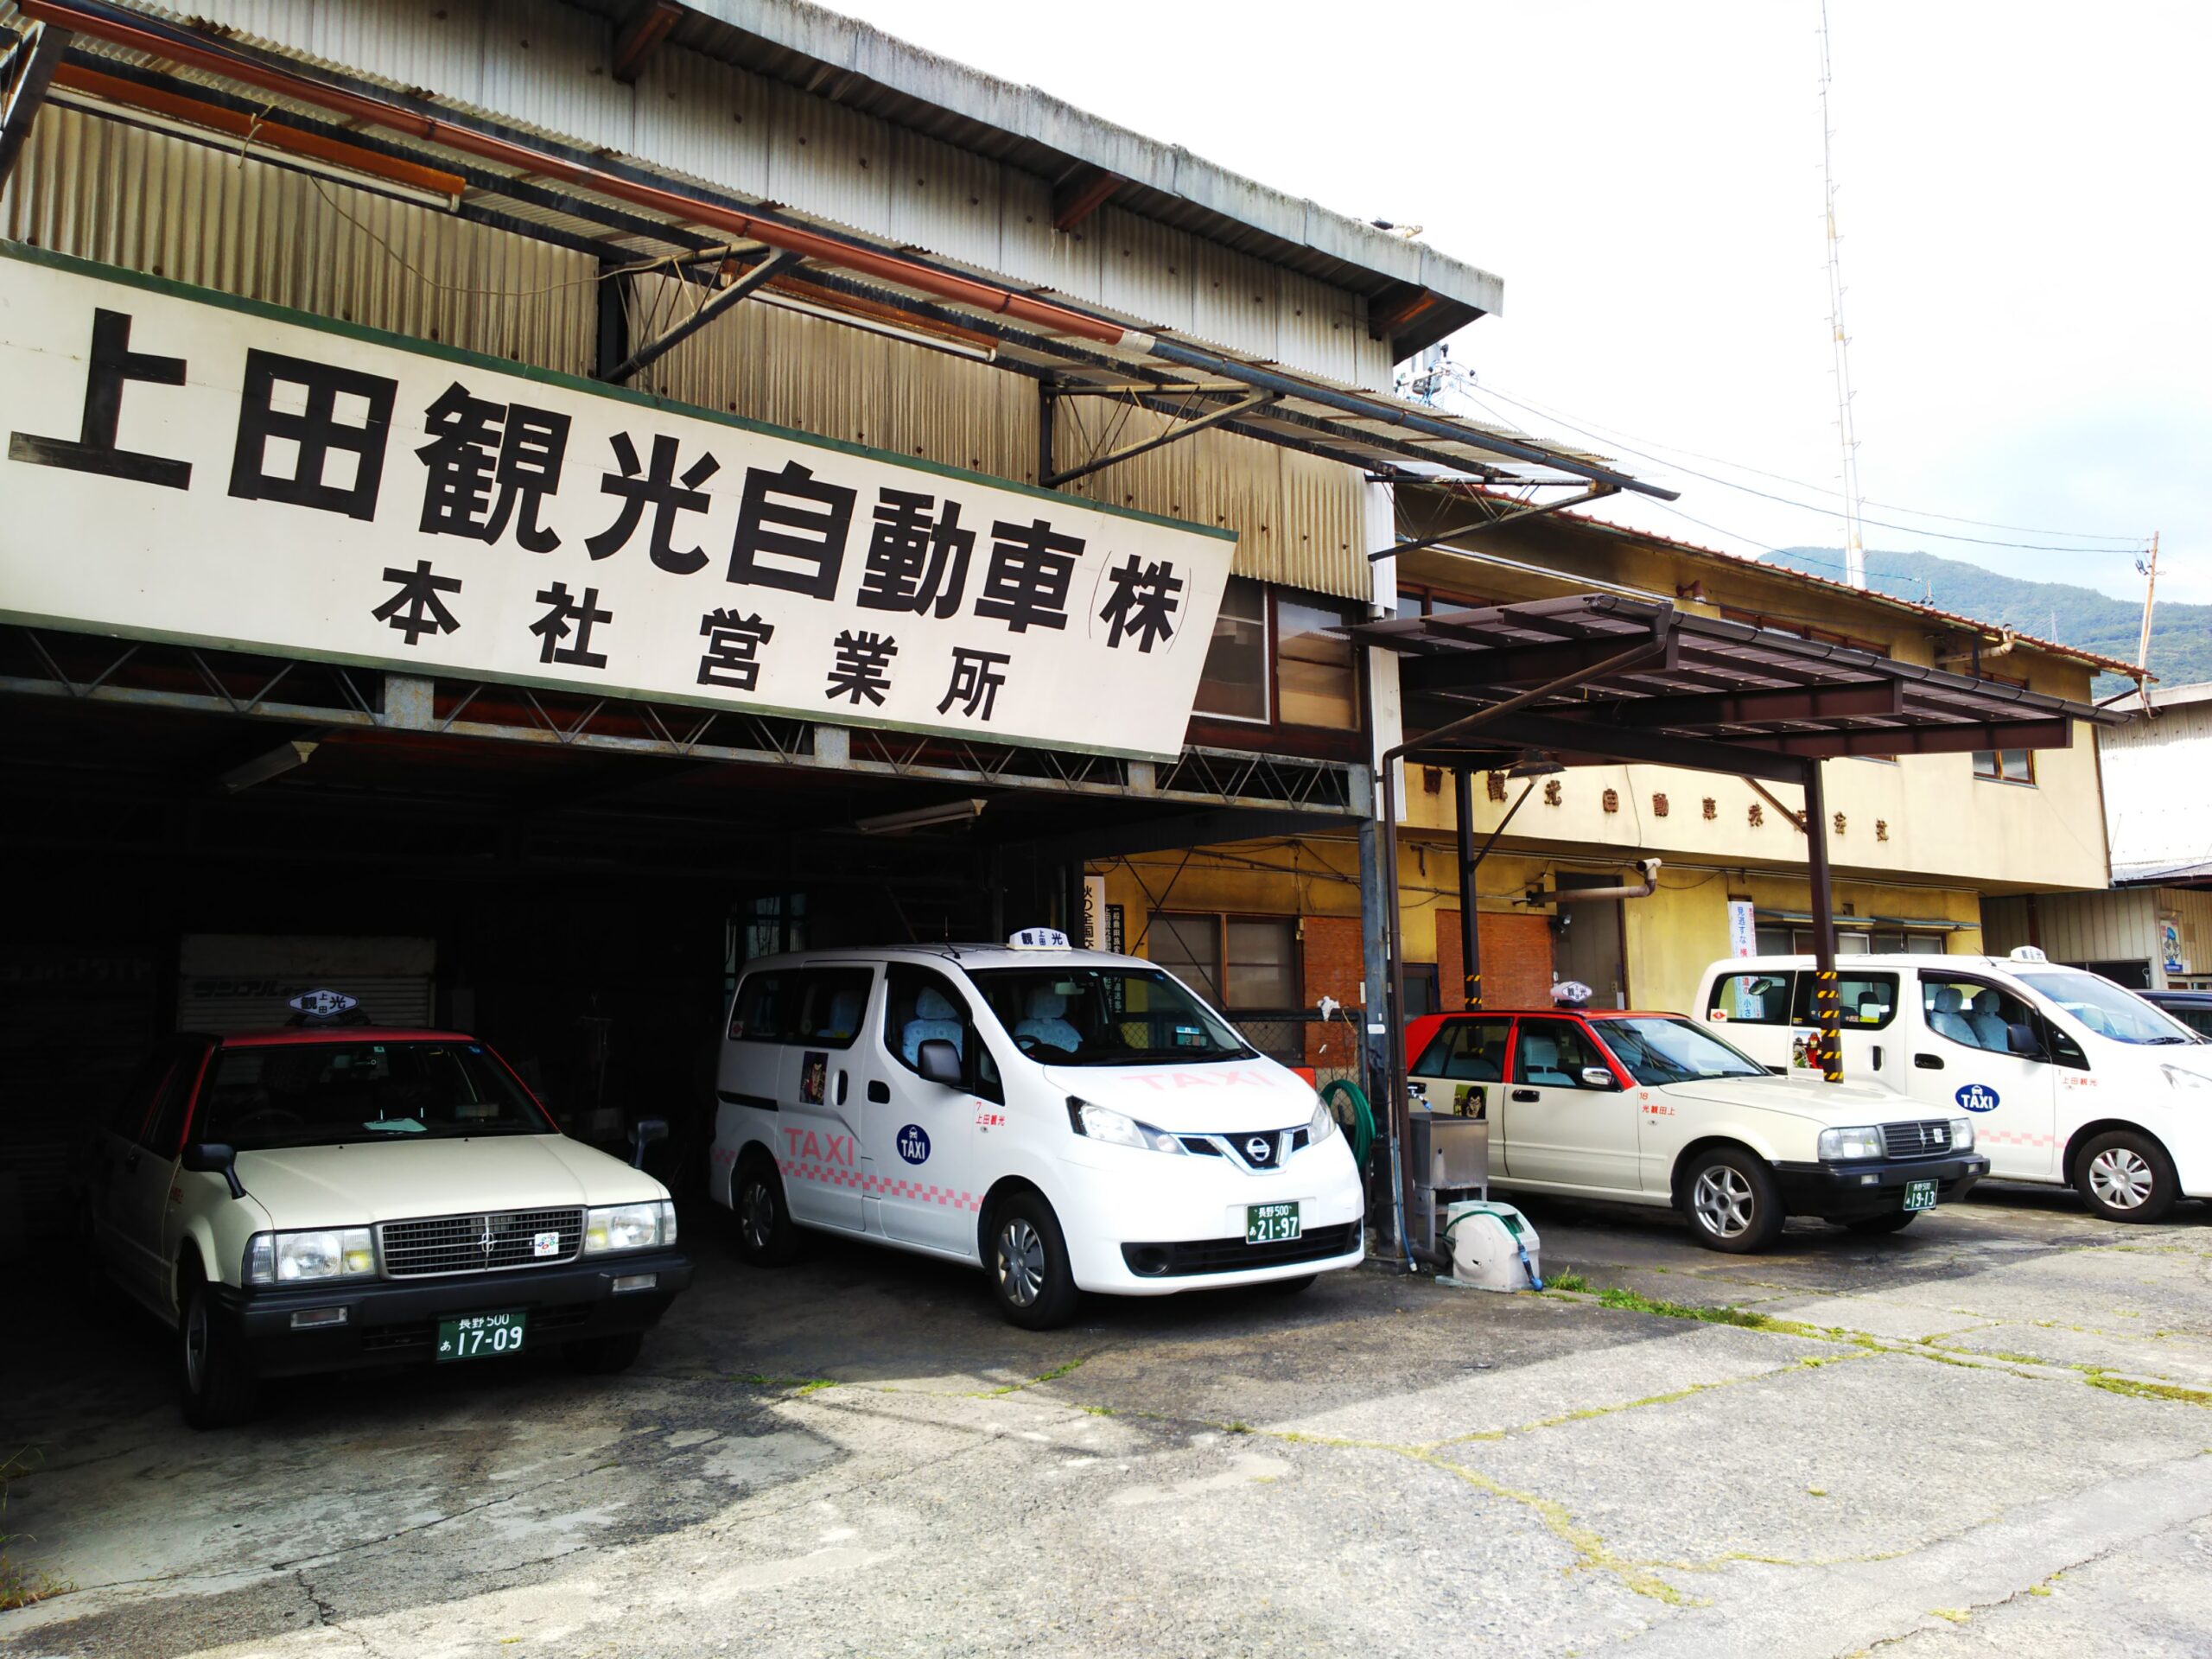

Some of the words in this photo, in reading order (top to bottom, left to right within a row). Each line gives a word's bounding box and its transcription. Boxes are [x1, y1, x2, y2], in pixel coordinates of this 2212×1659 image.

[372, 559, 1010, 721] 本社営業所
[1737, 906, 1746, 944] 見逃すな
[1120, 1071, 1275, 1090] TAXI
[2062, 1077, 2098, 1087] 上田観光
[1961, 1094, 1993, 1109] TAXI
[976, 1114, 1006, 1127] 上田観光
[783, 1127, 854, 1166] TAXI
[901, 1139, 925, 1160] TAXI
[1911, 1191, 1936, 1208] 19-13
[1258, 1206, 1274, 1218] 長野
[1274, 1205, 1289, 1217] 500
[1257, 1217, 1298, 1241] 21-97
[459, 1317, 485, 1331] 長野
[486, 1313, 510, 1327] 500
[440, 1340, 452, 1352] あ
[457, 1325, 523, 1356] 17-09
